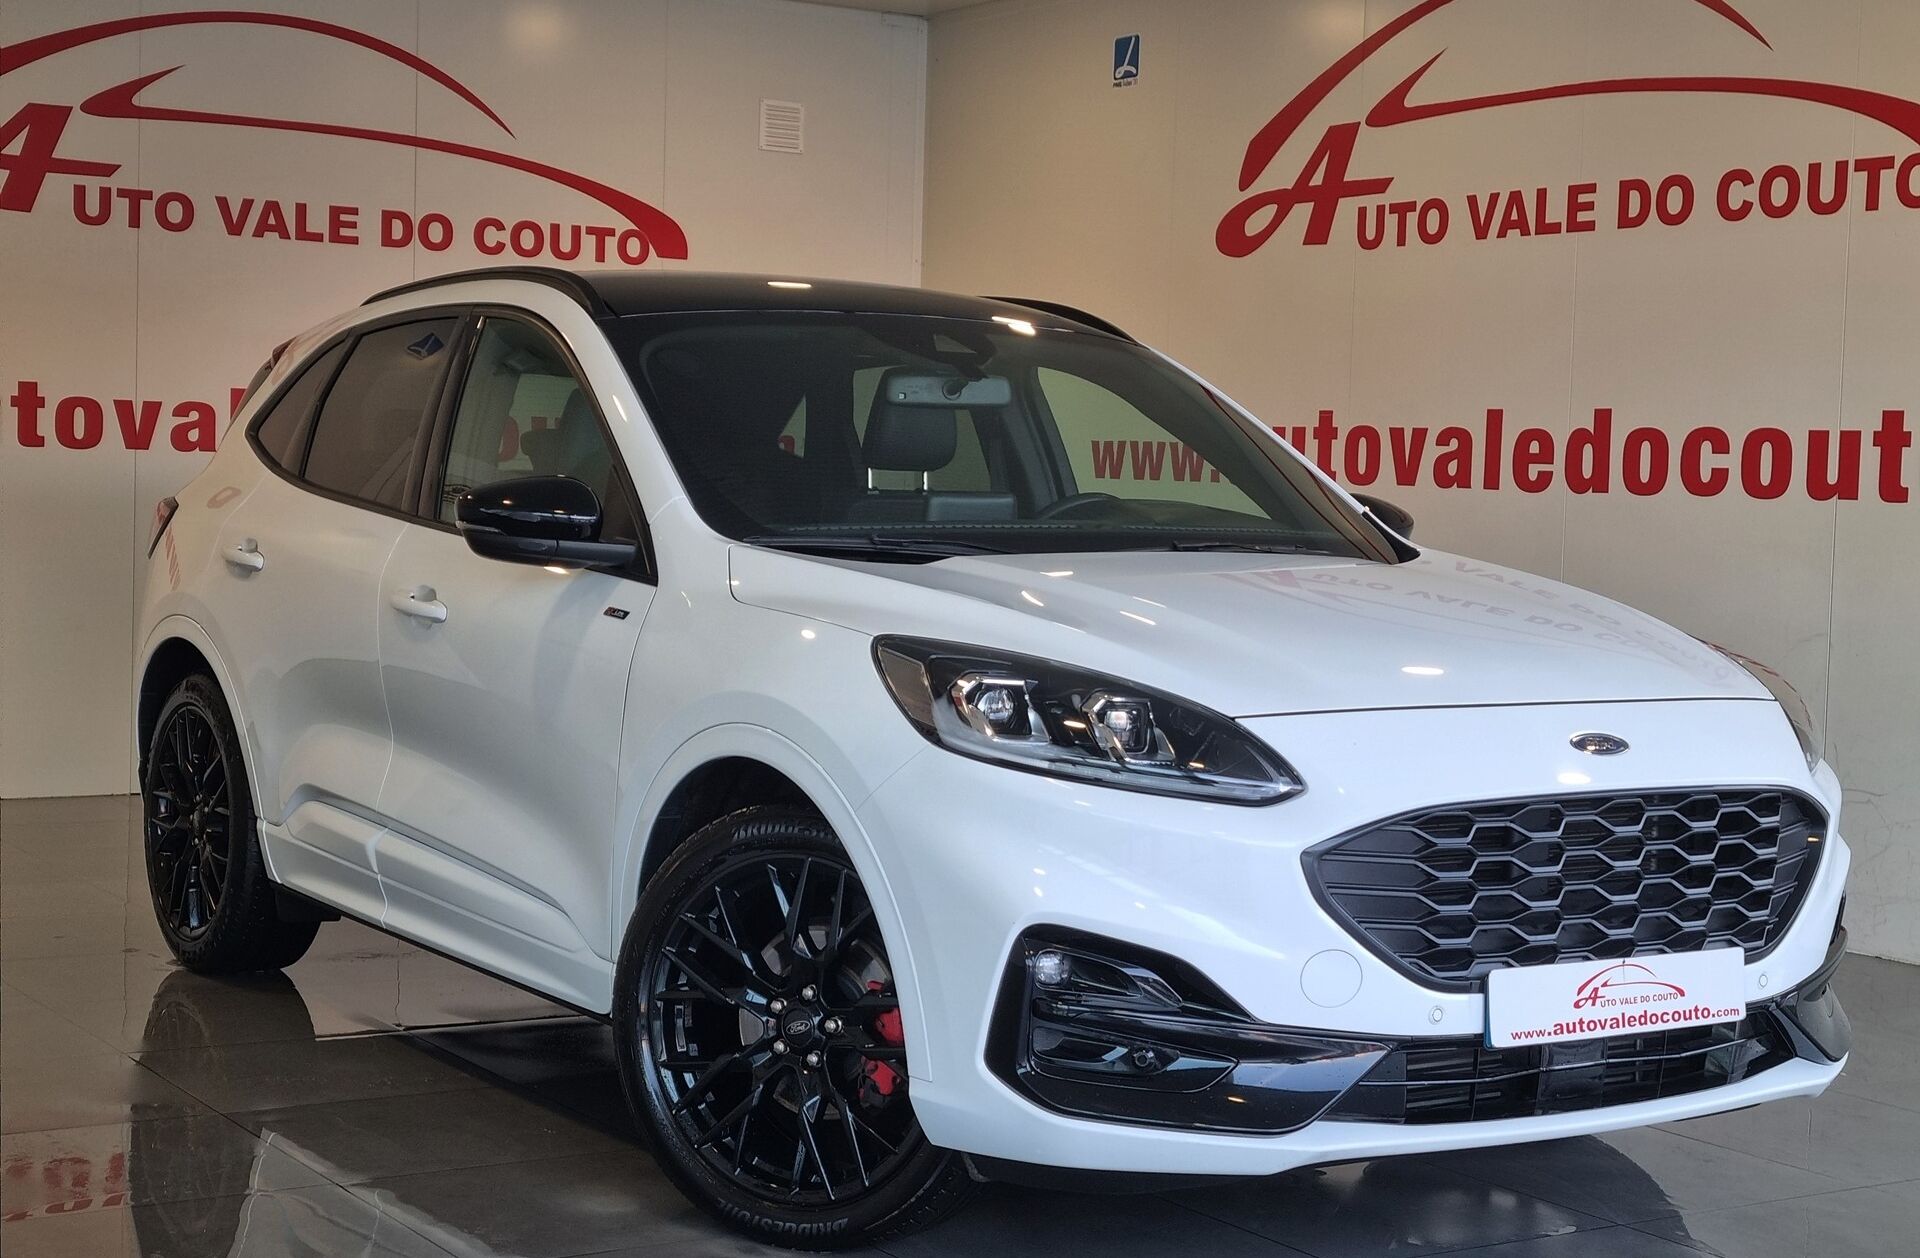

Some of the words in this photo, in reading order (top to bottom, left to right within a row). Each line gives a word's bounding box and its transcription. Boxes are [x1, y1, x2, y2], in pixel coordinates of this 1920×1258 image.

[215, 196, 359, 246] VALE
[380, 210, 454, 249] DO
[473, 217, 651, 266] COUTO
[1466, 182, 1597, 241] VALE
[1617, 174, 1695, 230] DO
[1511, 1005, 1741, 1041] www.autovaledocouto.com
[1619, 996, 1638, 1006] VALE
[1640, 994, 1651, 1004] DO
[1652, 992, 1679, 1003] COUTO
